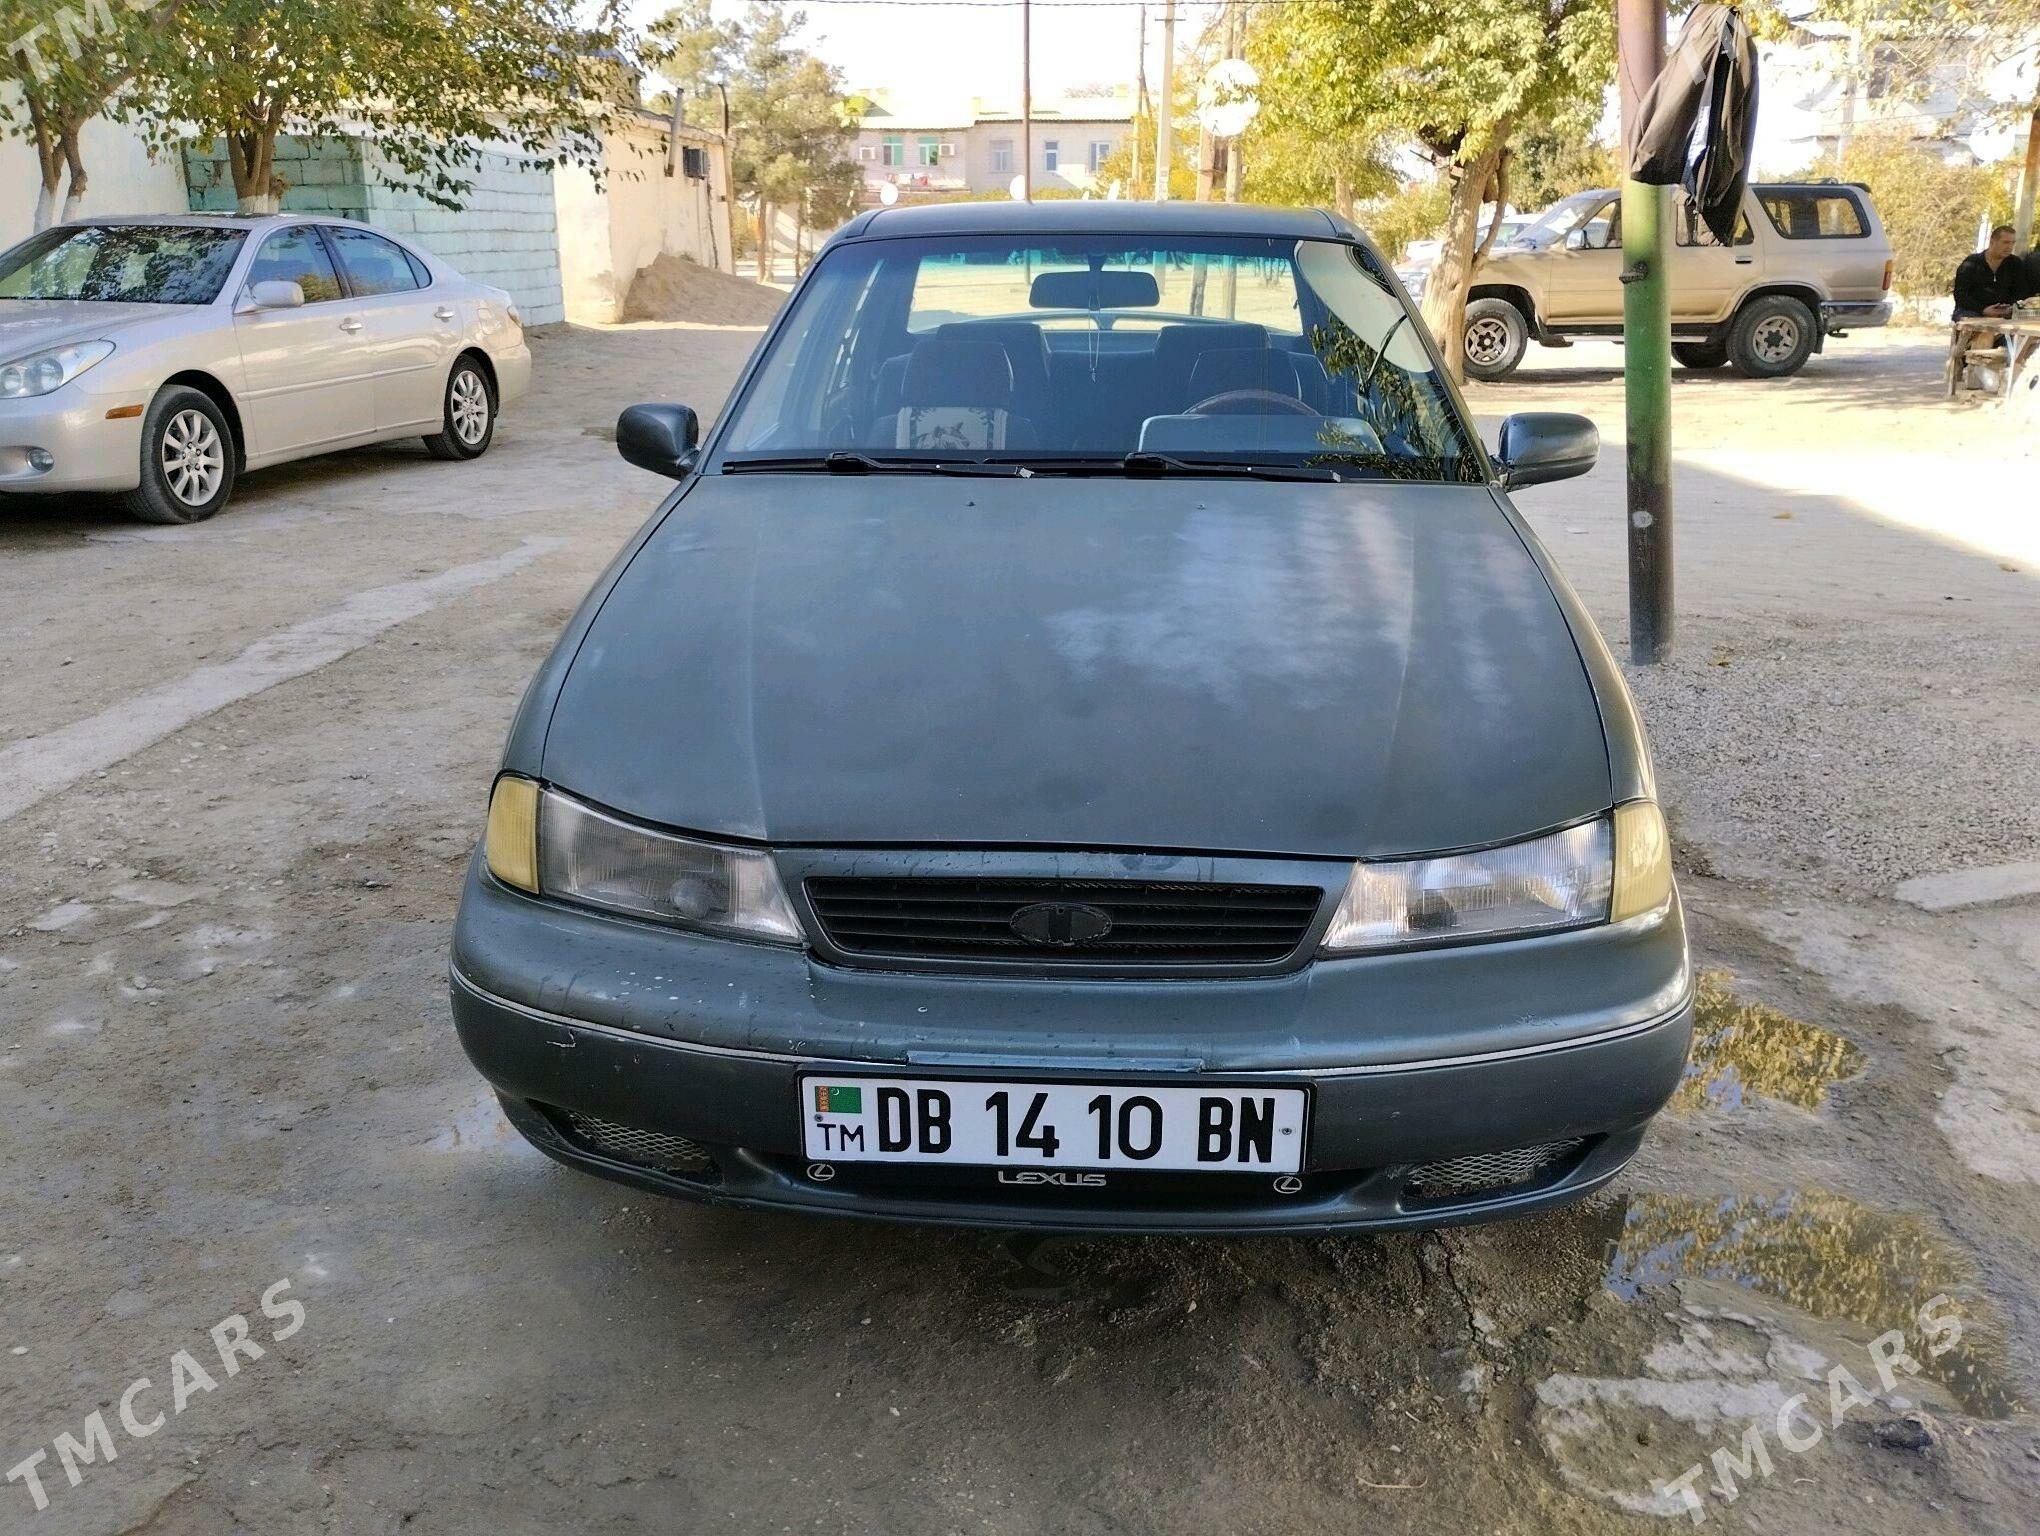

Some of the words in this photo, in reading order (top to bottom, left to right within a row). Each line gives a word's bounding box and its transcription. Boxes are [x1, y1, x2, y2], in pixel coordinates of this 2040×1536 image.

[816, 1123, 865, 1152] TM
[876, 1086, 952, 1155] DB
[985, 1091, 1060, 1158] 14
[1088, 1094, 1163, 1161] 10
[1197, 1096, 1275, 1163] BN
[997, 1170, 1107, 1187] LEXUS
